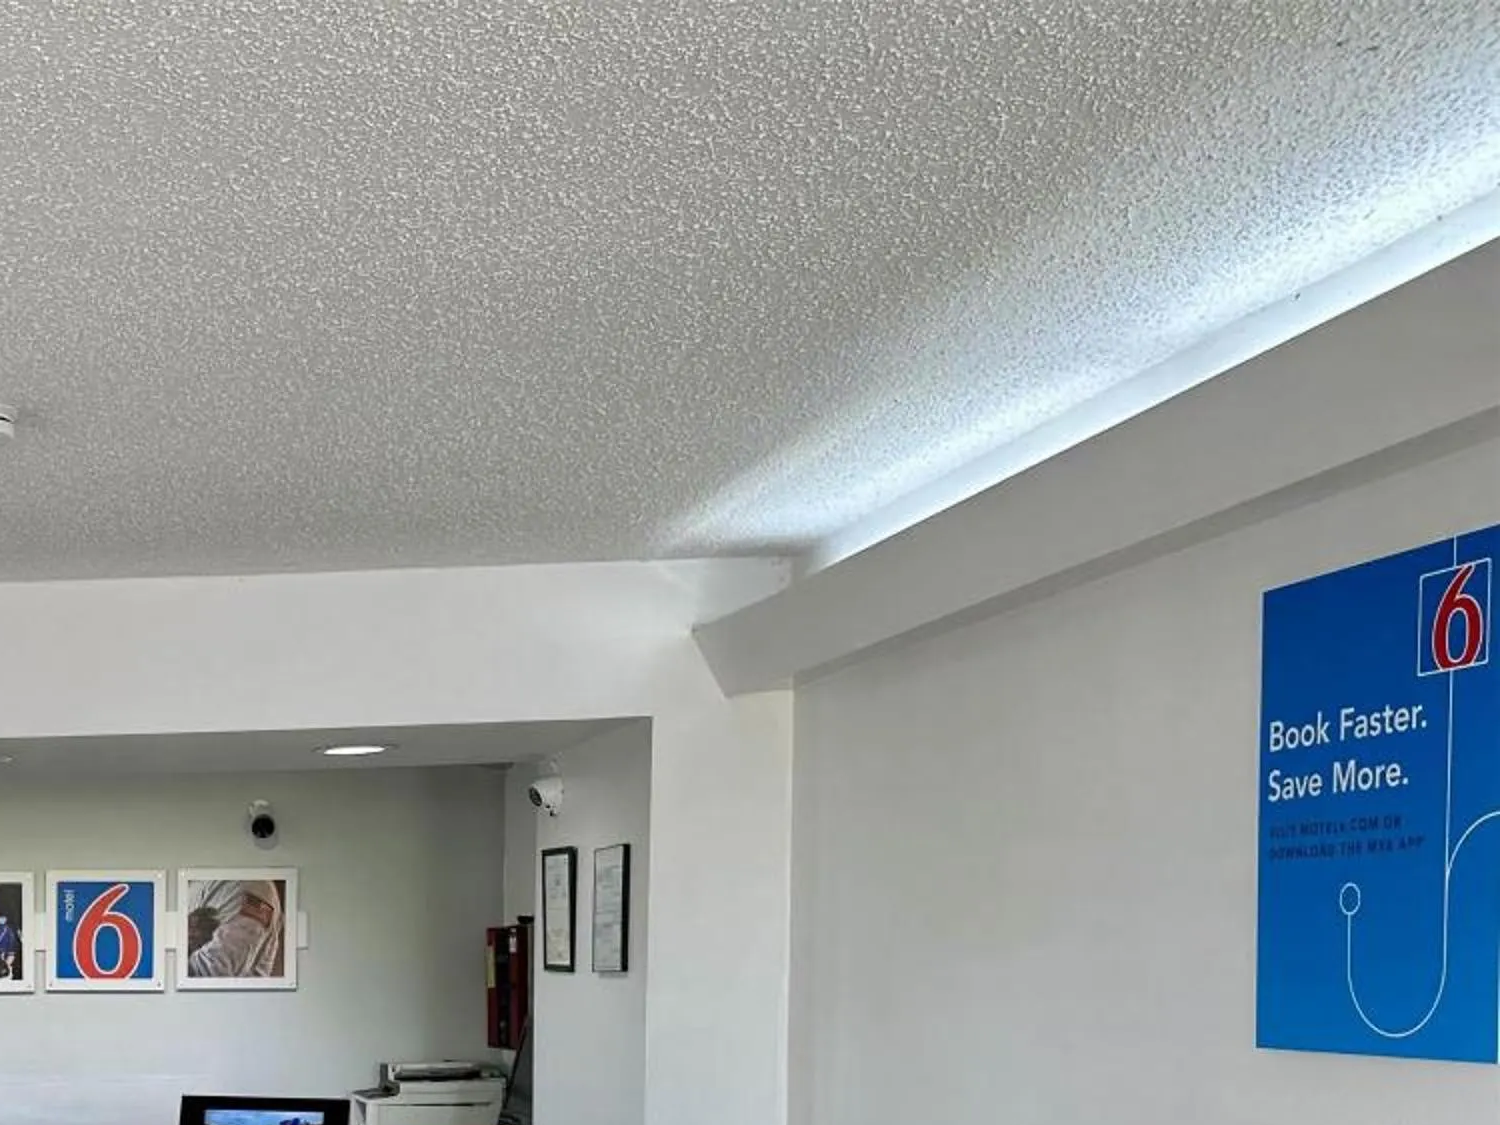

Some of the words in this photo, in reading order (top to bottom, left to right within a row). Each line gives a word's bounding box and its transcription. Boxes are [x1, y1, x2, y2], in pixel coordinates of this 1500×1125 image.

[1432, 562, 1483, 672] 6
[1269, 710, 1331, 752] Book
[1339, 703, 1428, 742] Faster.
[1267, 768, 1323, 803] Save
[1332, 759, 1409, 794] More.
[63, 889, 75, 922] motel
[73, 883, 142, 980] 6
